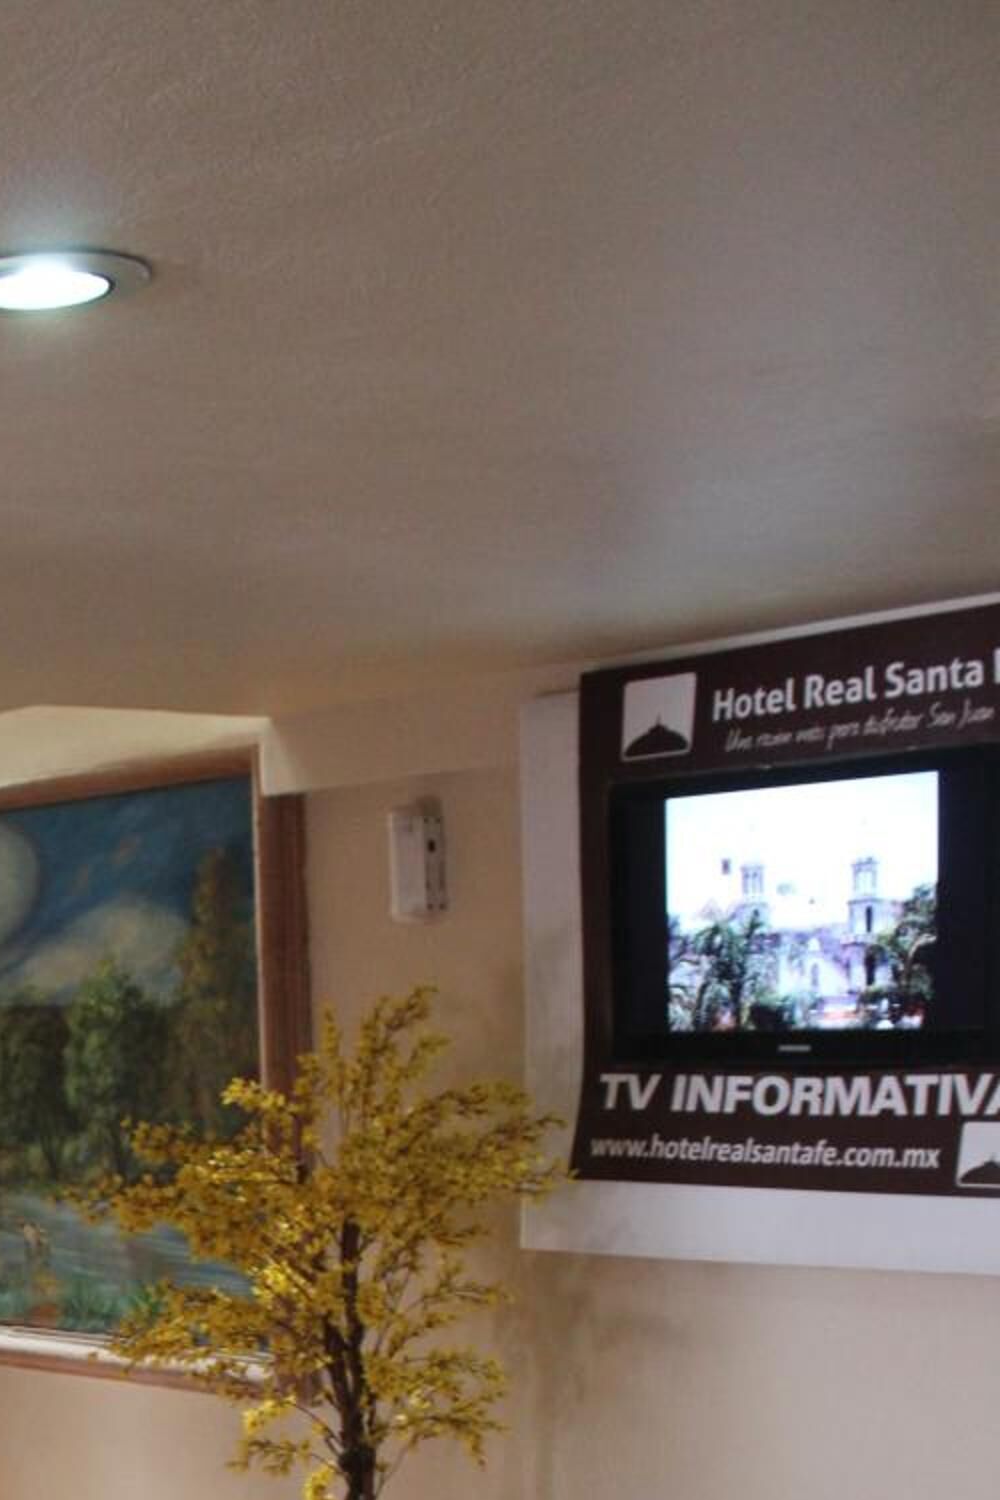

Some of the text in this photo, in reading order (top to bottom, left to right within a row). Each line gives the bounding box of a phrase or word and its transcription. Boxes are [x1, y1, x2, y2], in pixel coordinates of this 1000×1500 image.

[712, 677, 798, 722] Hotel
[803, 665, 877, 710] Real
[884, 658, 984, 699] Santa
[600, 1072, 662, 1111] TV
[590, 1132, 941, 1168] www.hotelrealsantafe.com.mx
